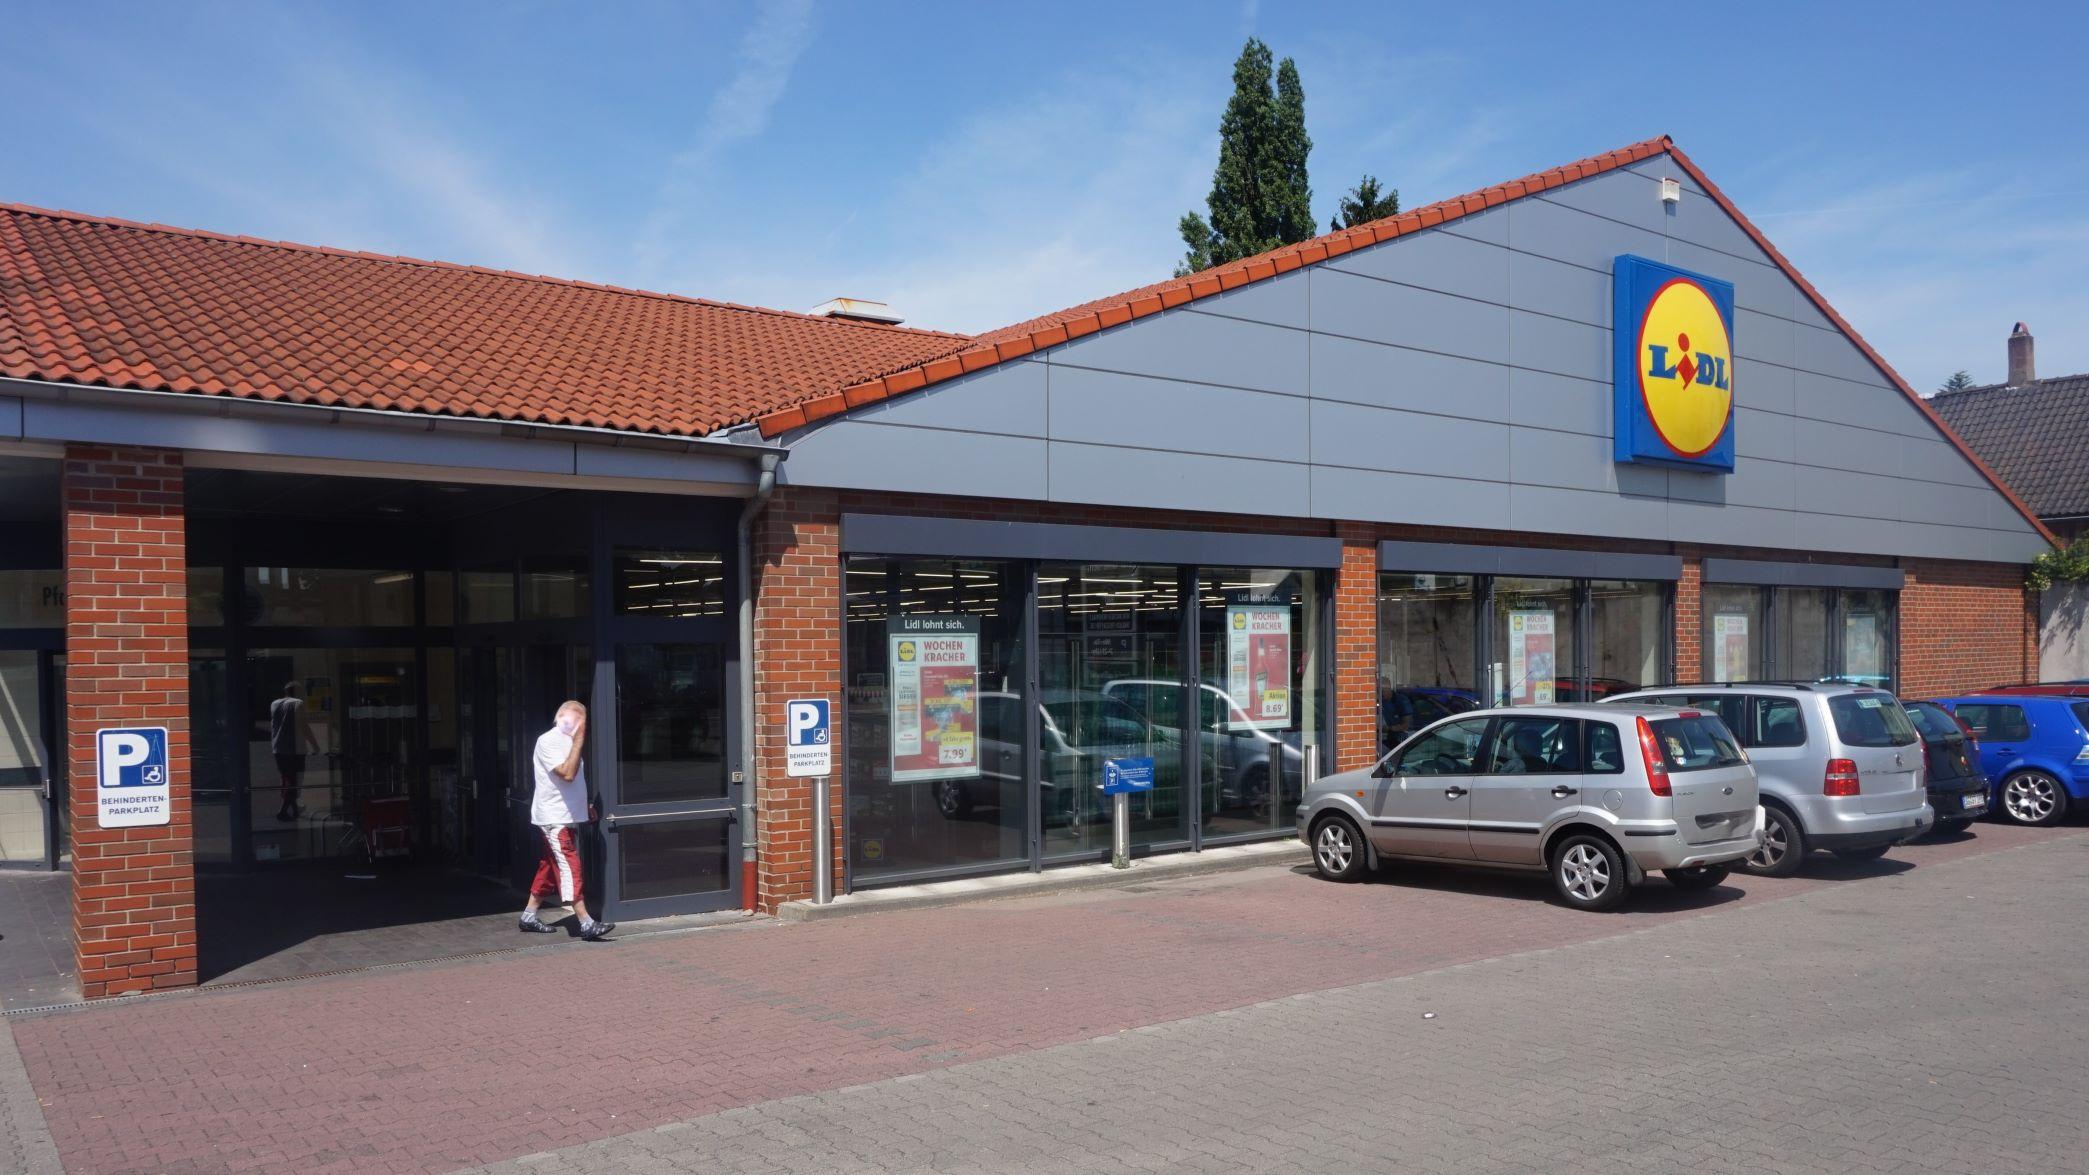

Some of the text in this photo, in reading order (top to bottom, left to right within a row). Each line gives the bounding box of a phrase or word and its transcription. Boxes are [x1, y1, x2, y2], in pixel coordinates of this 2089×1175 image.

[1252, 611, 1280, 621] WOCHEN
[904, 619, 965, 629] Lidl lohnt sich.
[1252, 622, 1282, 630] KRACHER
[923, 641, 963, 650] WOCHEN
[923, 652, 966, 662] KRACHER
[790, 703, 819, 745] P
[102, 733, 150, 786] P
[101, 795, 167, 805] BEHINDERTEN-
[108, 805, 159, 815] PARKPLATZ
